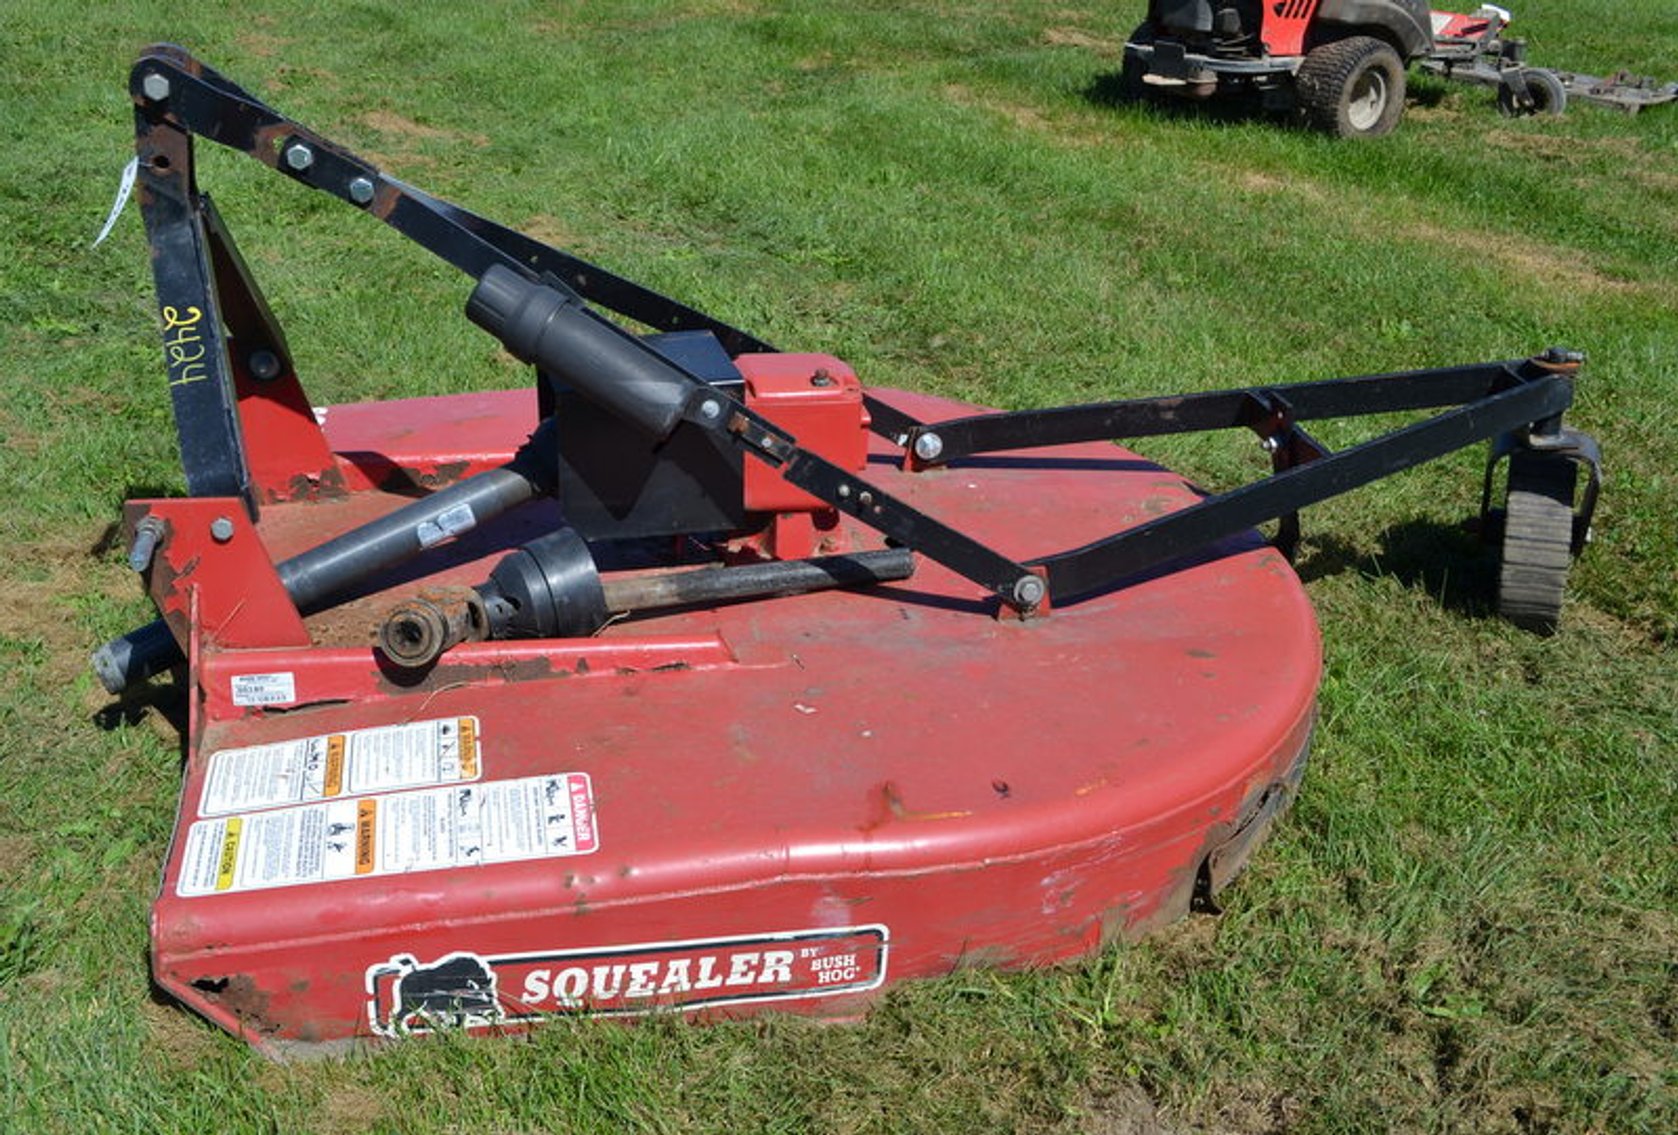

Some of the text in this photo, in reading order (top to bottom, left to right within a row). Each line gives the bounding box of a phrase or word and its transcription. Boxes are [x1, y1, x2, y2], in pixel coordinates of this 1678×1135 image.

[163, 306, 207, 386] 2424
[572, 794, 591, 841] DANGER
[222, 841, 236, 874] CAUTION
[359, 820, 371, 865] WARNING
[800, 947, 819, 958] BY
[810, 953, 857, 972] BUSH
[521, 950, 795, 1009] SQUEALER
